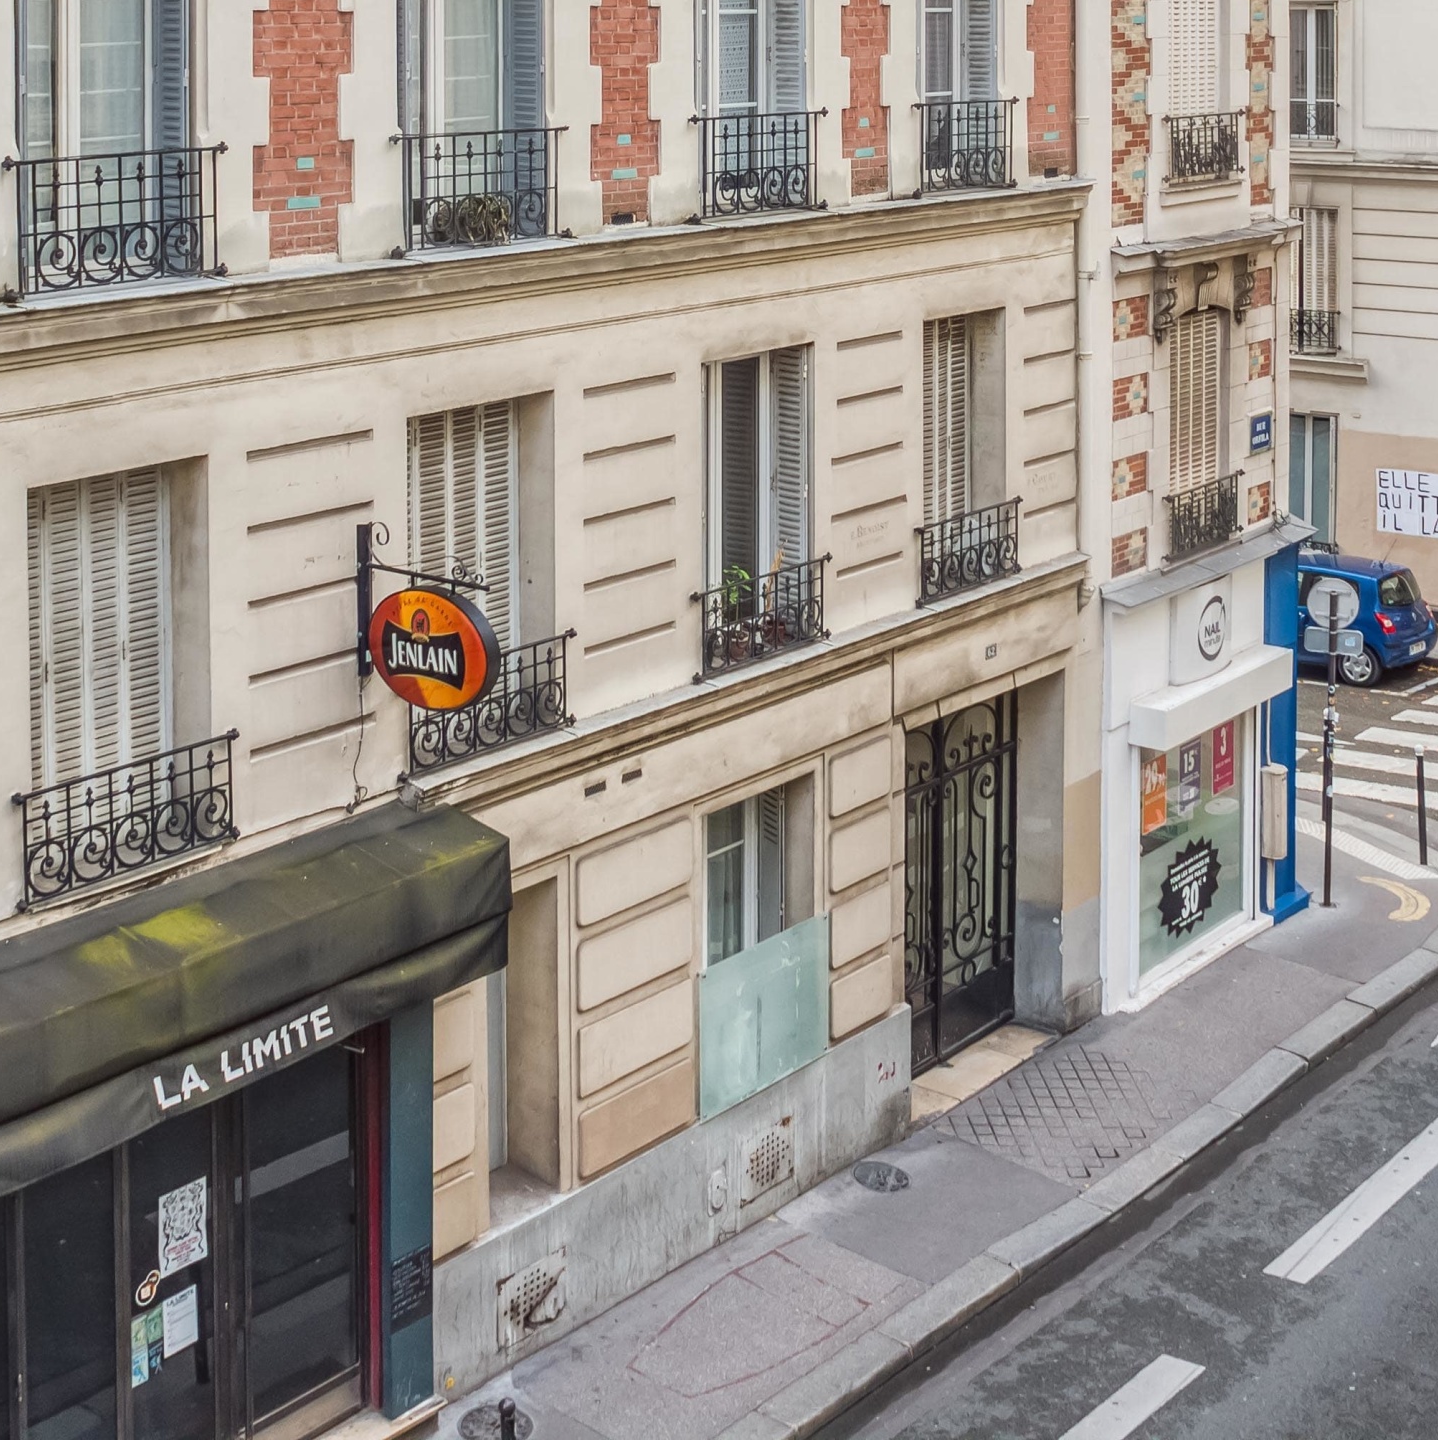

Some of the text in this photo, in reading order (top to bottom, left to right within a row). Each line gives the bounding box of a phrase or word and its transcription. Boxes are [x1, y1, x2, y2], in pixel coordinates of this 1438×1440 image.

[1378, 470, 1430, 493] ELLE
[1204, 621, 1221, 638] NAIL
[388, 633, 457, 676] JENLAIN
[153, 1005, 334, 1110] LA LIMITE
